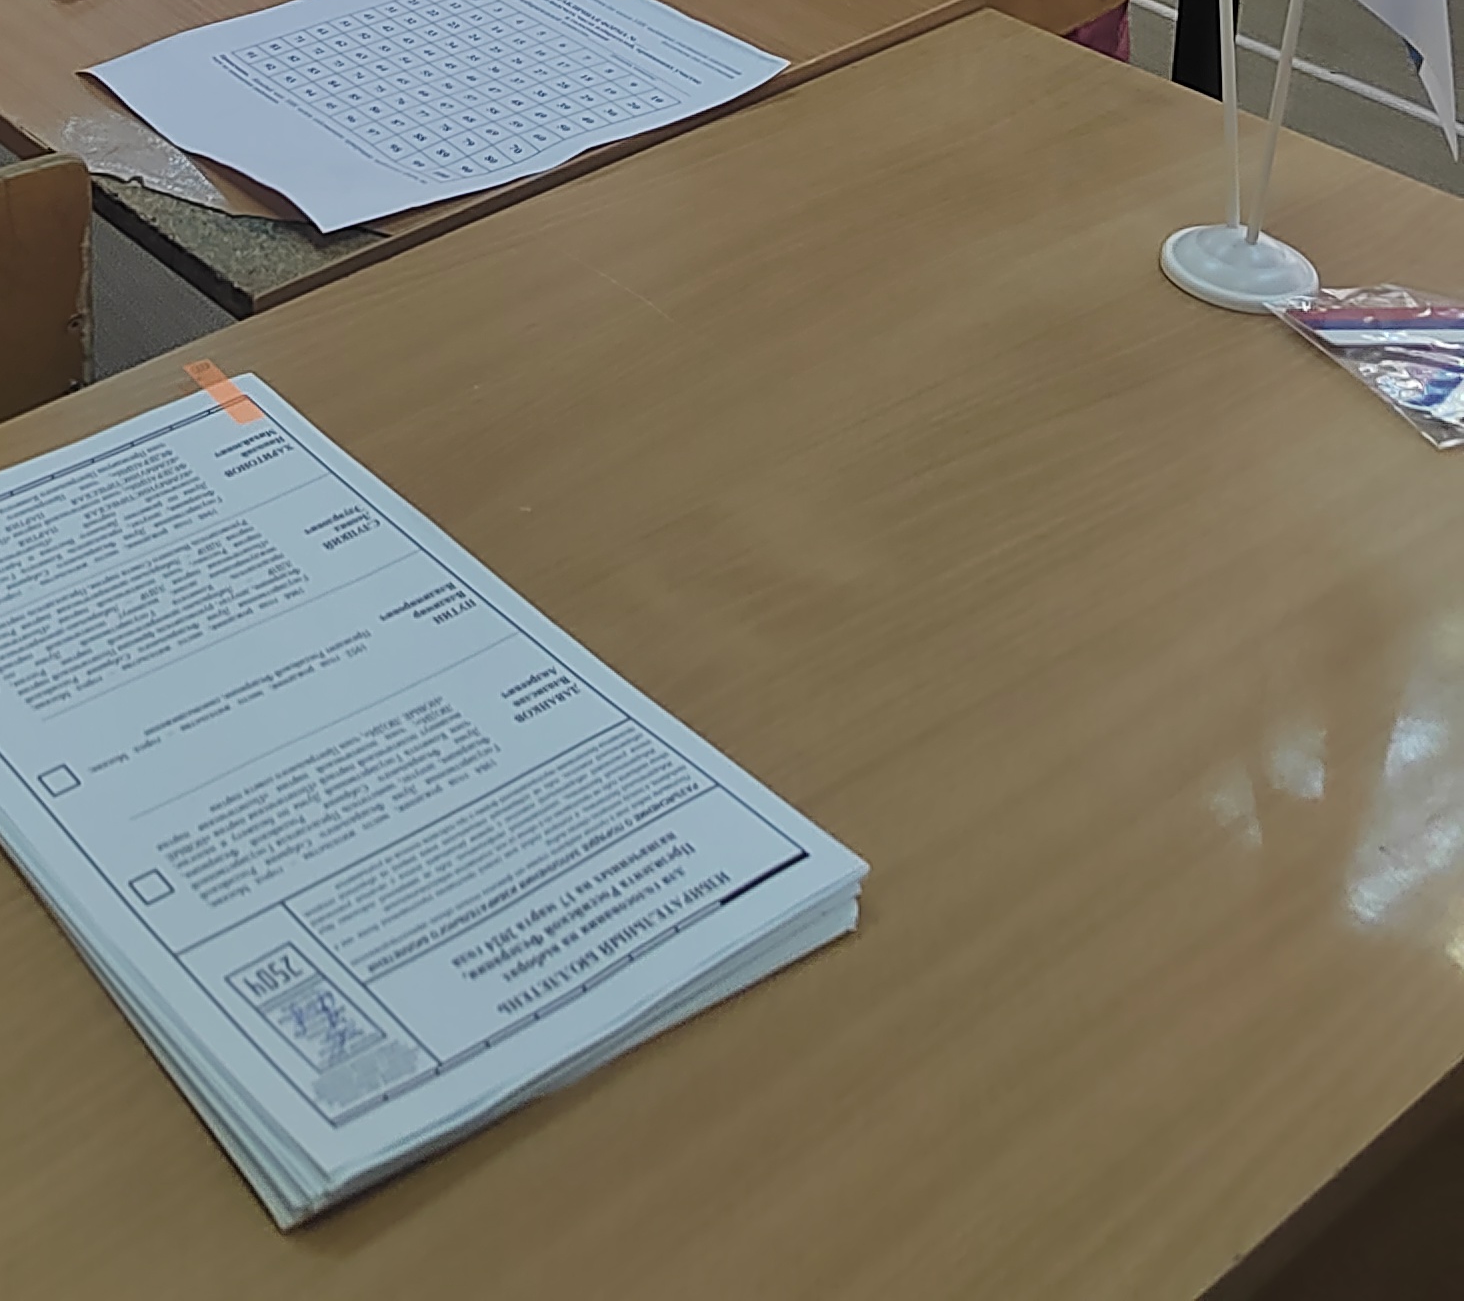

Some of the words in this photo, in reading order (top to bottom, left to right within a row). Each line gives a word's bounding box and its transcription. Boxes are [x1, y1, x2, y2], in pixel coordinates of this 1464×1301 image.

[224, 444, 293, 477] ХАРИТОНОВ
[432, 599, 477, 624] ПУТИН
[514, 683, 580, 723] ДАВАНКОВ
[243, 955, 302, 996] 2504
